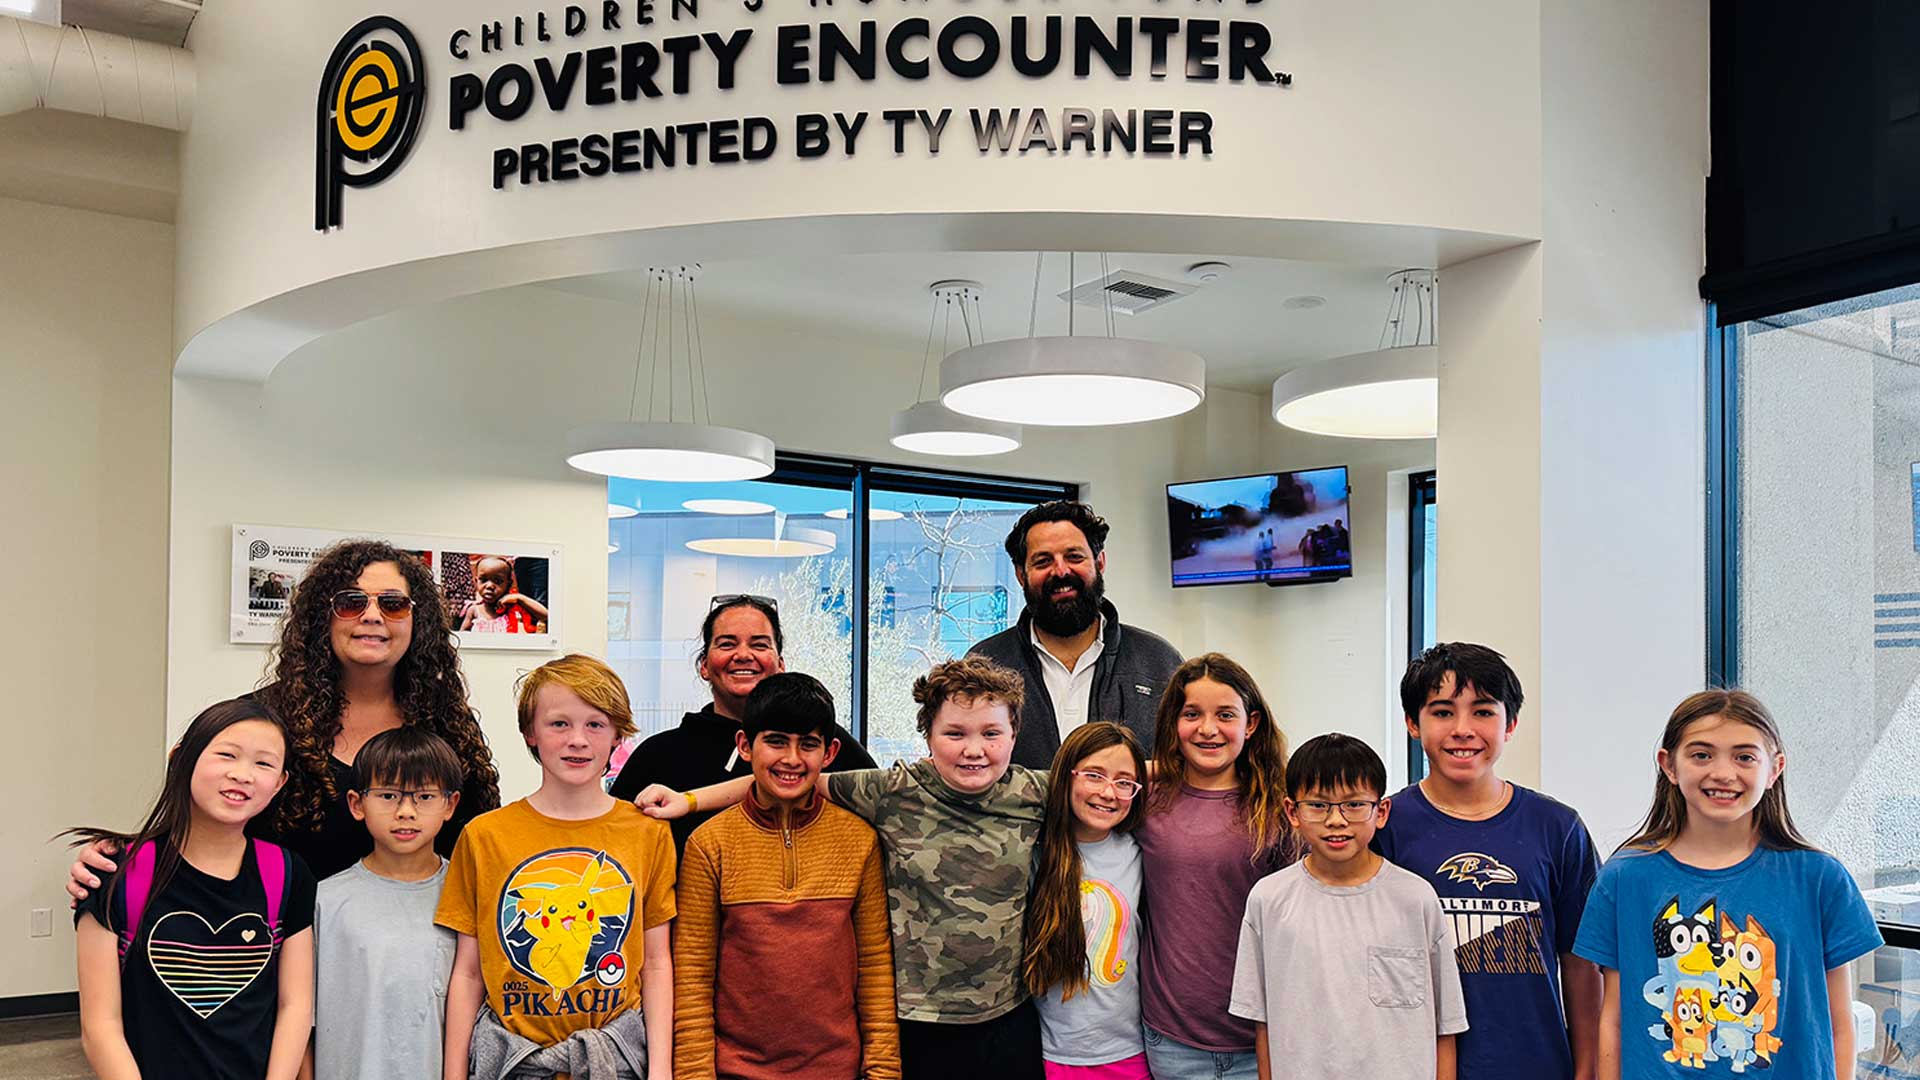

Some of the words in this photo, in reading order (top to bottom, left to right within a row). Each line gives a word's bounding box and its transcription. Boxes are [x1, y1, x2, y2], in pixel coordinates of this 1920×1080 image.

[449, 0, 763, 59] CHILDREN
[449, 27, 753, 130] POVERTY
[777, 16, 1275, 85] ENCOUNTER
[493, 117, 777, 190] PRESENTED
[797, 112, 869, 157] BY
[883, 108, 952, 153] TY
[970, 108, 1214, 155] WARNER
[503, 981, 529, 991] 0025
